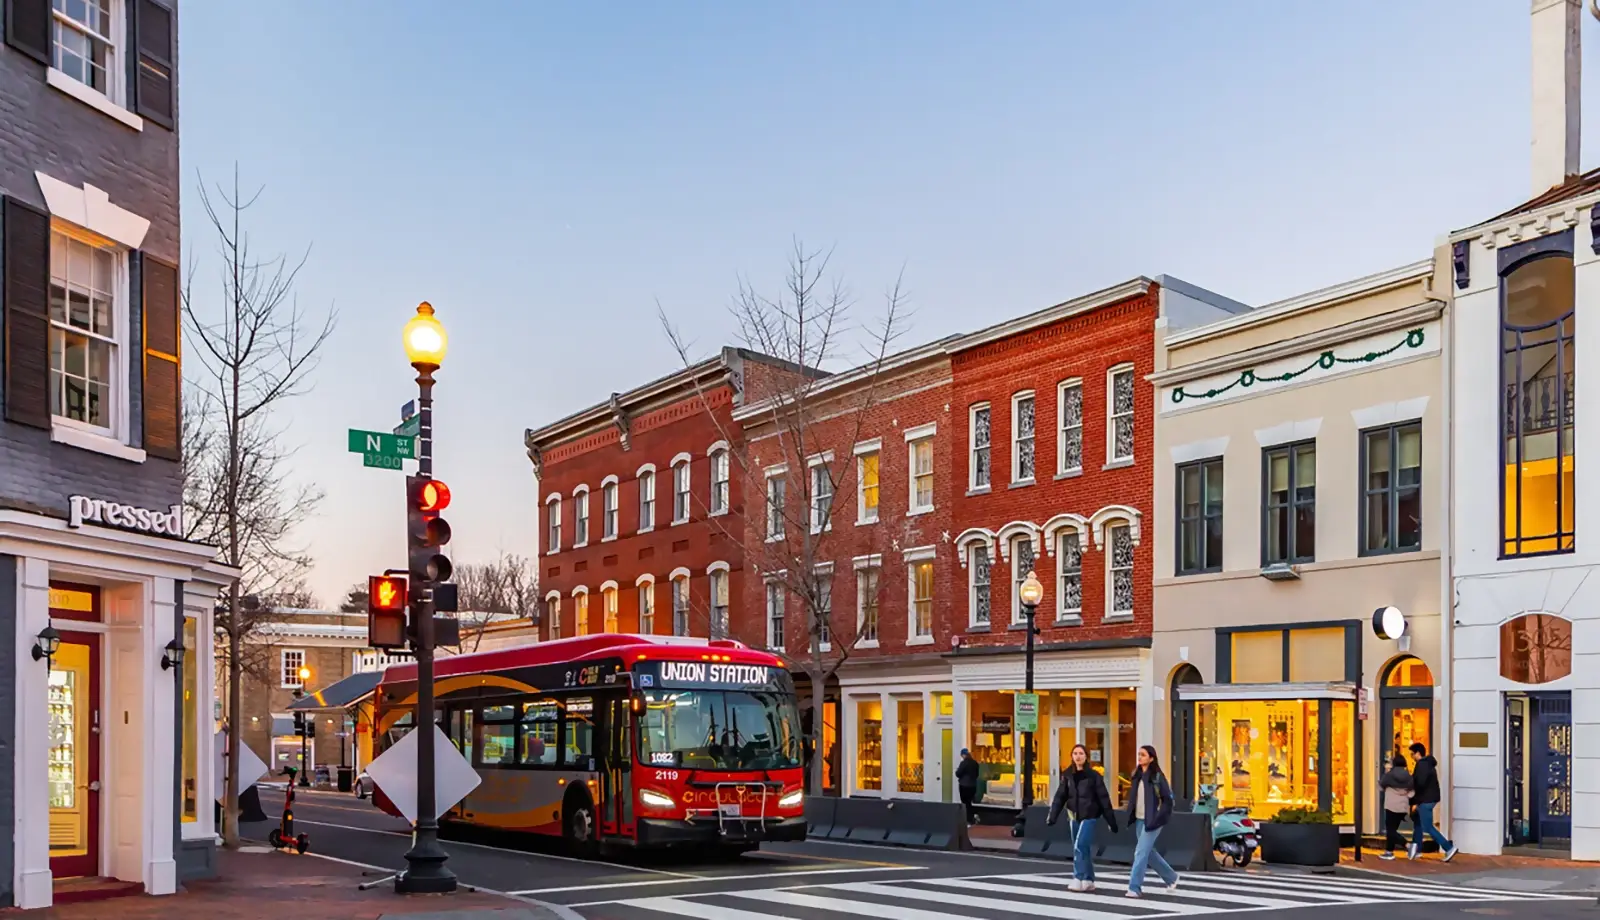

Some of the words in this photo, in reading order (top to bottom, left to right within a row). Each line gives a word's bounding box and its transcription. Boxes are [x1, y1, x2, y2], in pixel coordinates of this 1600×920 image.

[367, 434, 381, 452] N
[366, 454, 401, 468] 3200
[69, 495, 182, 537] pressed
[661, 661, 706, 682] UNION
[709, 664, 768, 684] STATION
[655, 771, 678, 780] 2119
